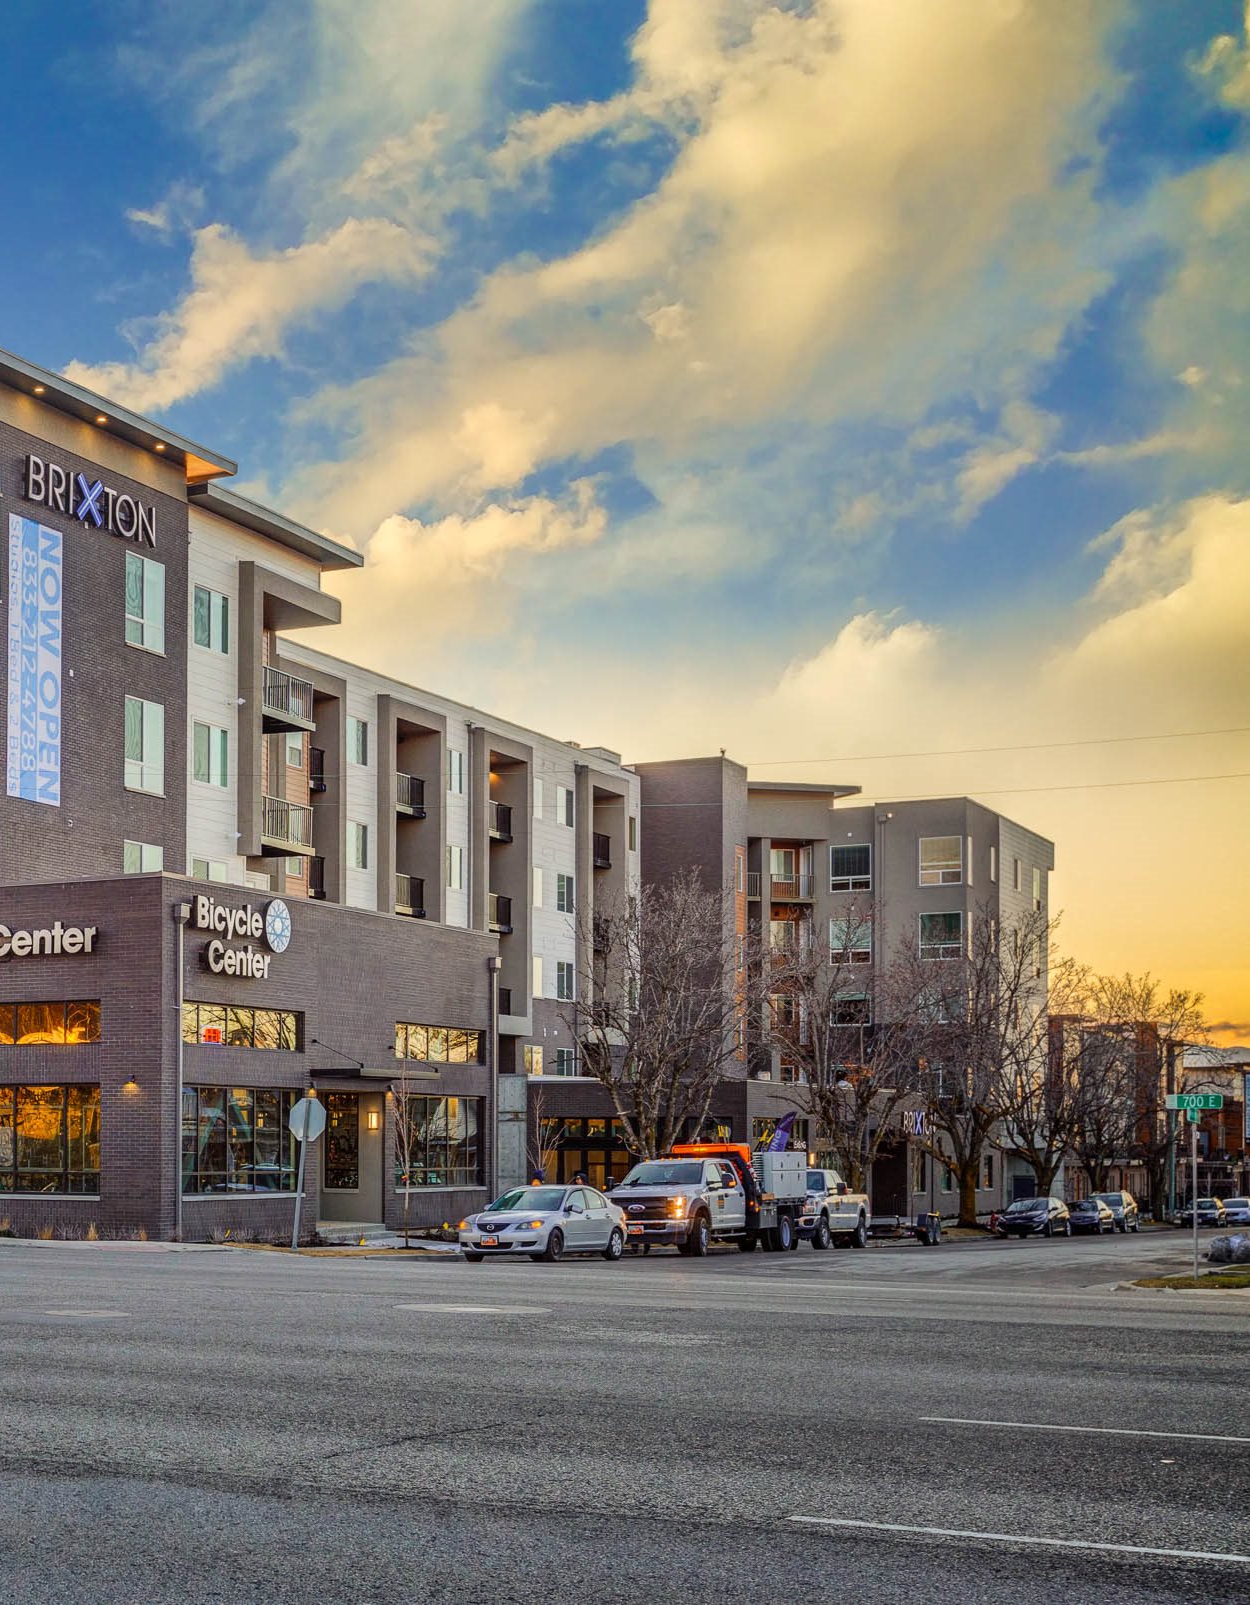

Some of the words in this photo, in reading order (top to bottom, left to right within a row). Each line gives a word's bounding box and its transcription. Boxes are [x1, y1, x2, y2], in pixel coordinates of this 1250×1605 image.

[28, 454, 156, 547] BRIXTON
[40, 531, 60, 657] NOW
[22, 547, 37, 771] 833-212-4788
[9, 736, 18, 792] Beds
[39, 671, 59, 801] OPEN
[197, 895, 264, 940] Bicycle
[208, 939, 271, 979] Center
[1182, 1096, 1204, 1107] 700
[1208, 1096, 1215, 1107] E
